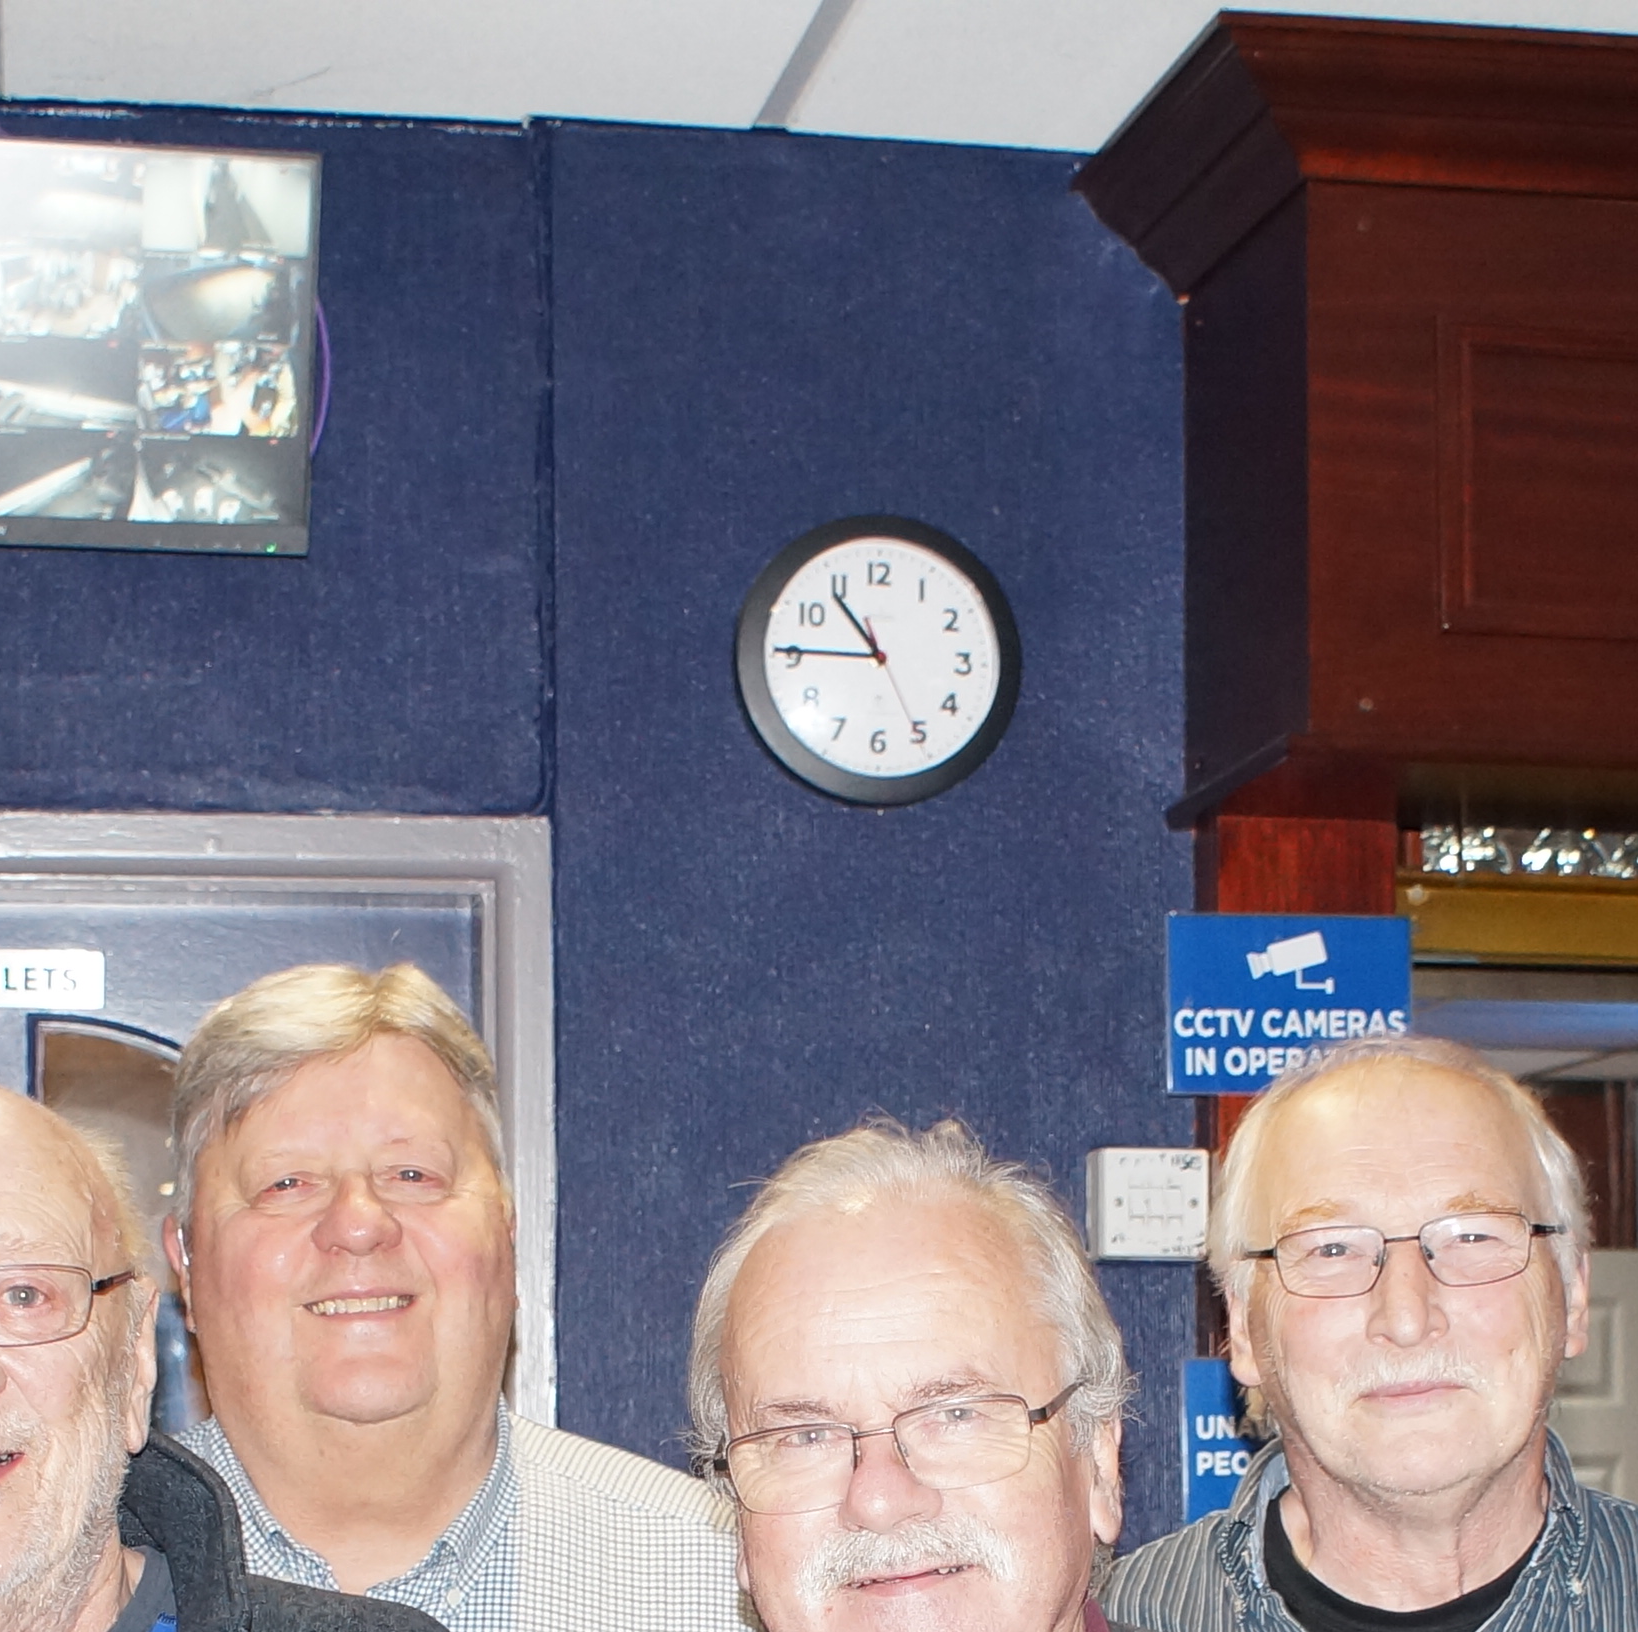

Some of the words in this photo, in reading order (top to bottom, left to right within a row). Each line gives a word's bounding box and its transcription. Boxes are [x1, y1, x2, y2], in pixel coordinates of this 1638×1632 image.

[867, 562, 891, 586] 12
[918, 578, 925, 602] 1
[799, 602, 825, 626] 10
[943, 608, 959, 632] 2
[785, 645, 802, 668] 9
[954, 652, 972, 676] 3
[941, 692, 958, 716] 4
[831, 717, 847, 741] 7
[910, 720, 927, 744] 5
[870, 730, 886, 754] 6
[1174, 1009, 1254, 1038] CCTV
[1262, 1008, 1407, 1039] CAMERAS
[1185, 1047, 1215, 1076] IN
